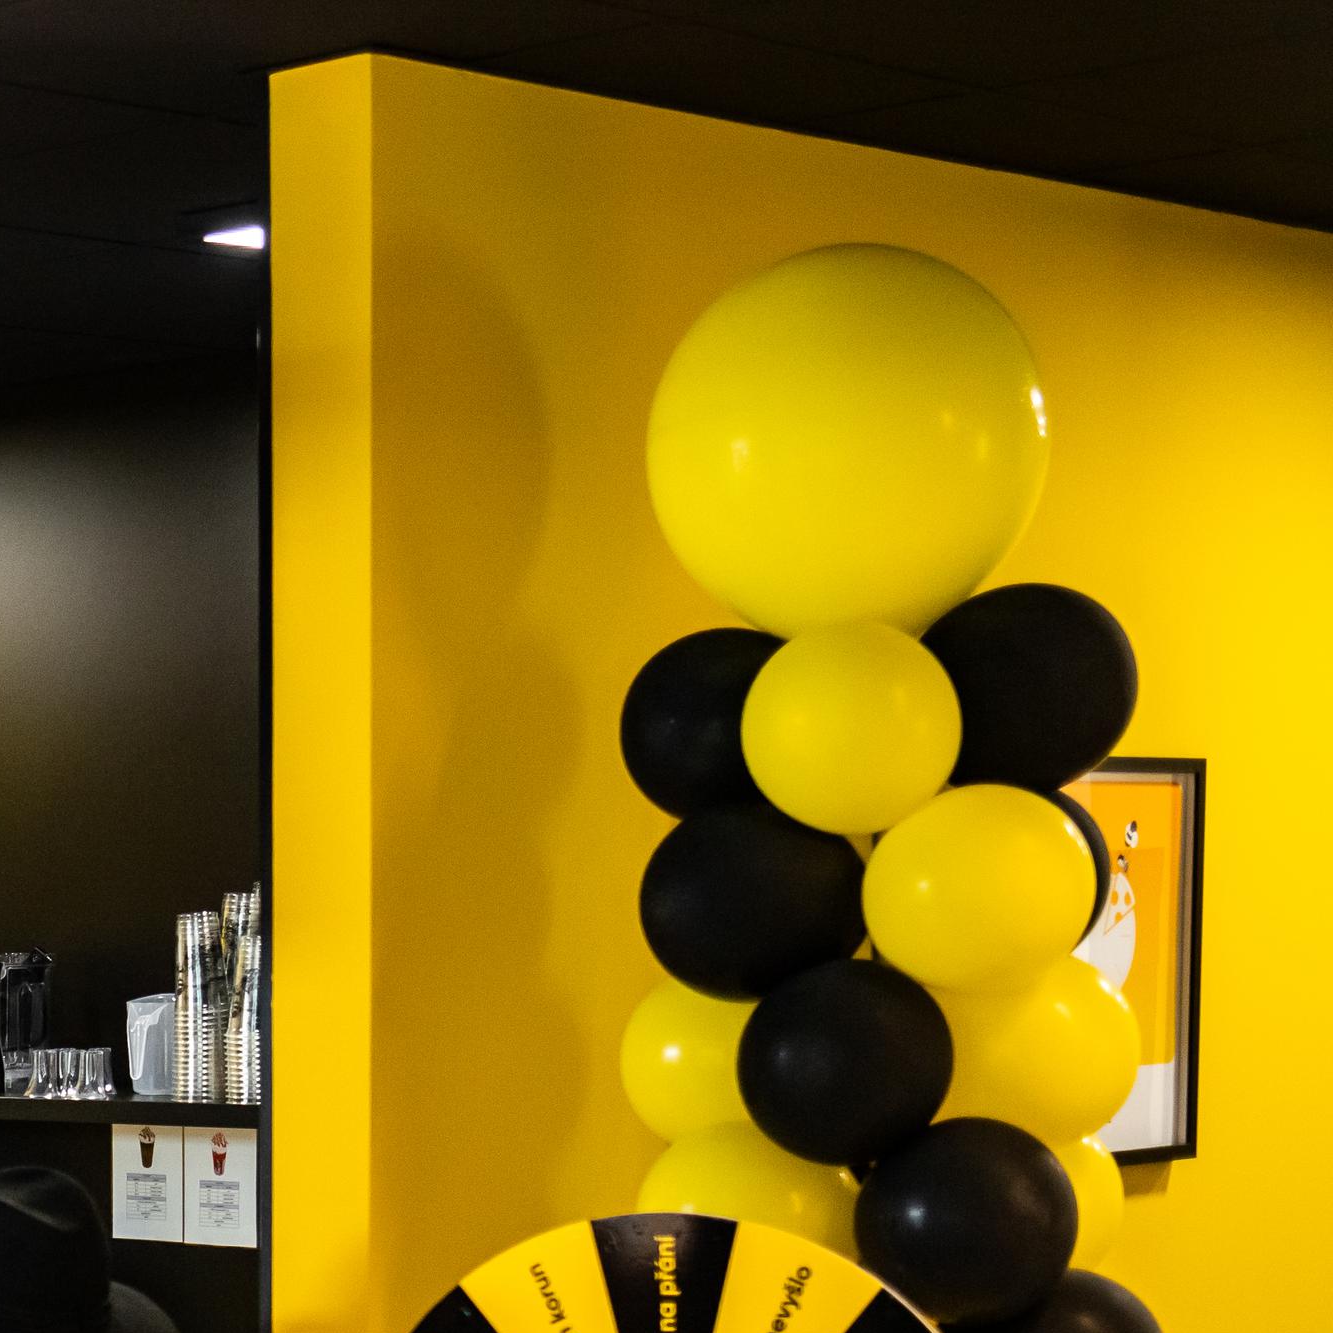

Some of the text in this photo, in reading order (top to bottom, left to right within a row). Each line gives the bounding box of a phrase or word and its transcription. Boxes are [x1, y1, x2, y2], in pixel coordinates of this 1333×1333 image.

[530, 1263, 565, 1324] korun
[653, 1235, 682, 1296] přání
[659, 1302, 677, 1332] na
